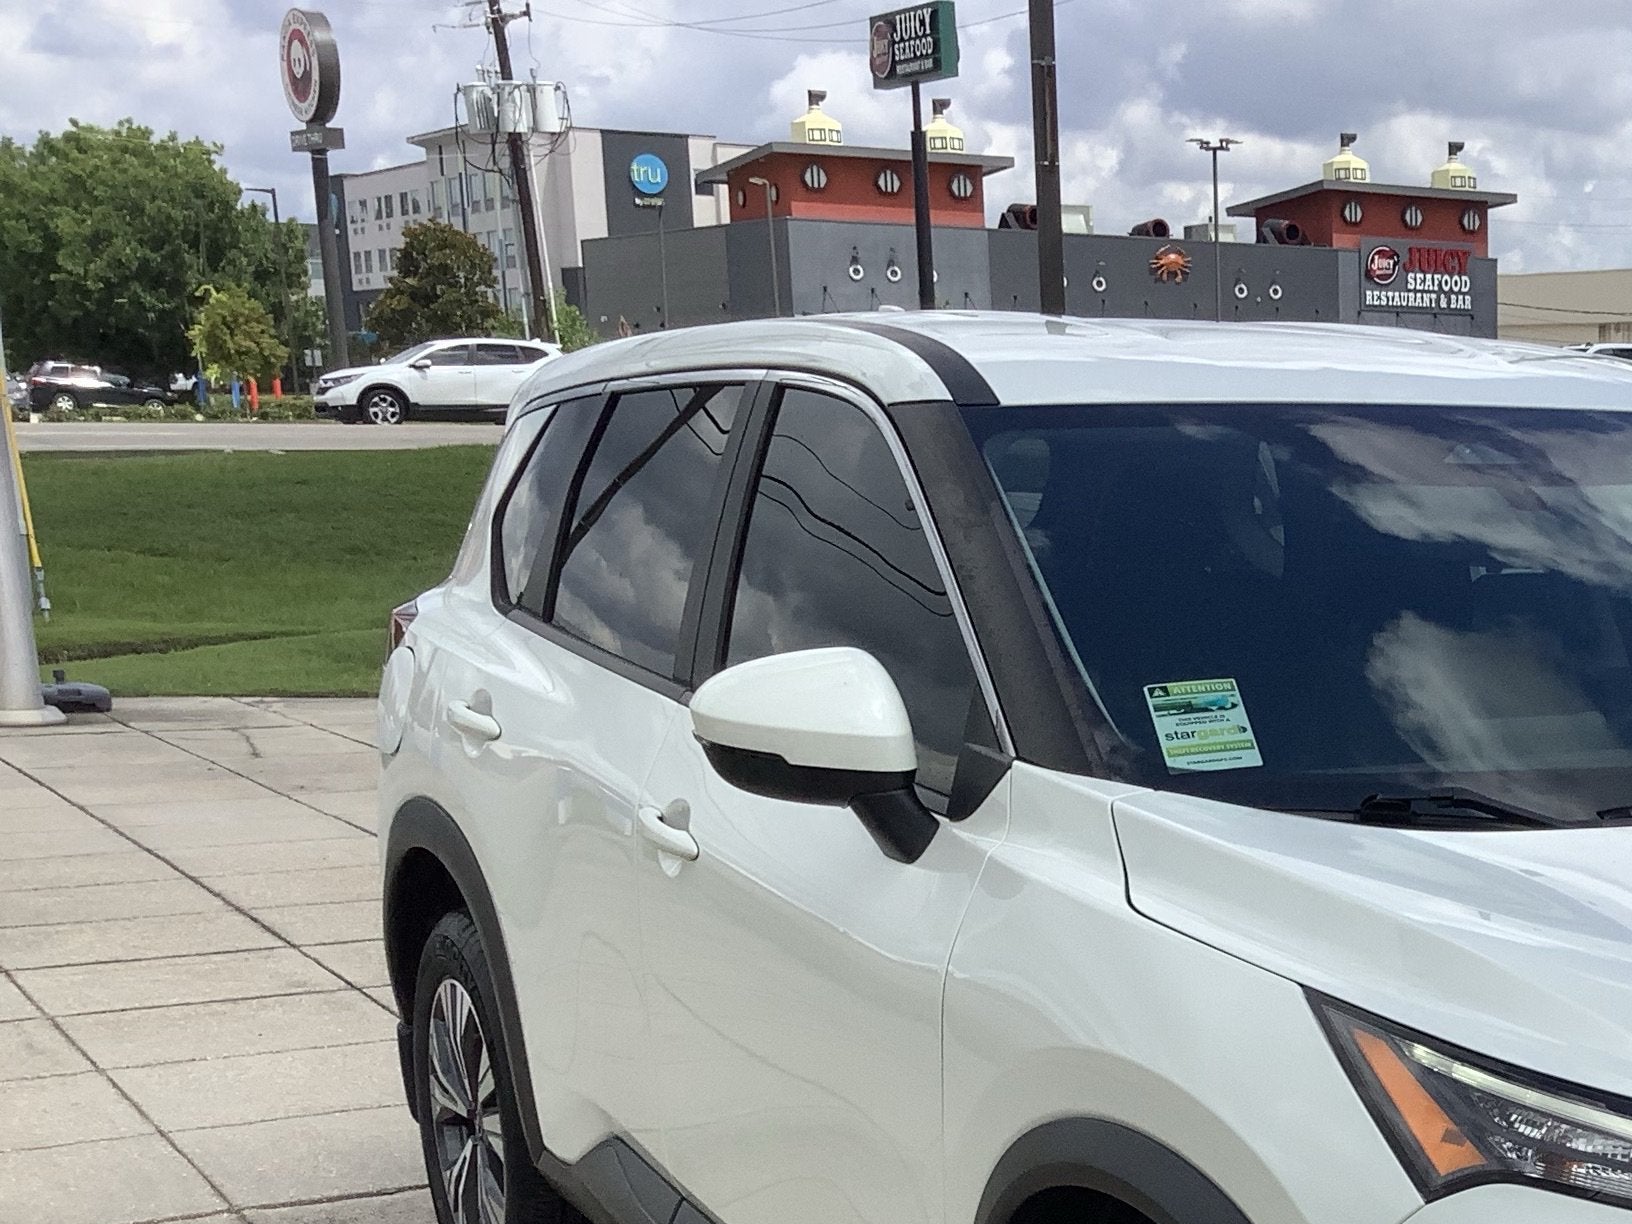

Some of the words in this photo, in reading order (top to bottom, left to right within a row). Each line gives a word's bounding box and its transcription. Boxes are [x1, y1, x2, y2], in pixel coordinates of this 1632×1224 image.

[894, 8, 932, 41] JUICY
[894, 36, 933, 60] SEAFOOD
[631, 162, 661, 183] tru
[1403, 246, 1472, 273] JUICY
[1407, 272, 1470, 292] SEAFOOD
[1365, 290, 1437, 307] RESTAURANT
[1440, 294, 1447, 308] &
[1450, 294, 1471, 309] BAR
[1174, 683, 1232, 694] ATTENTION
[1164, 725, 1240, 741] stargard
